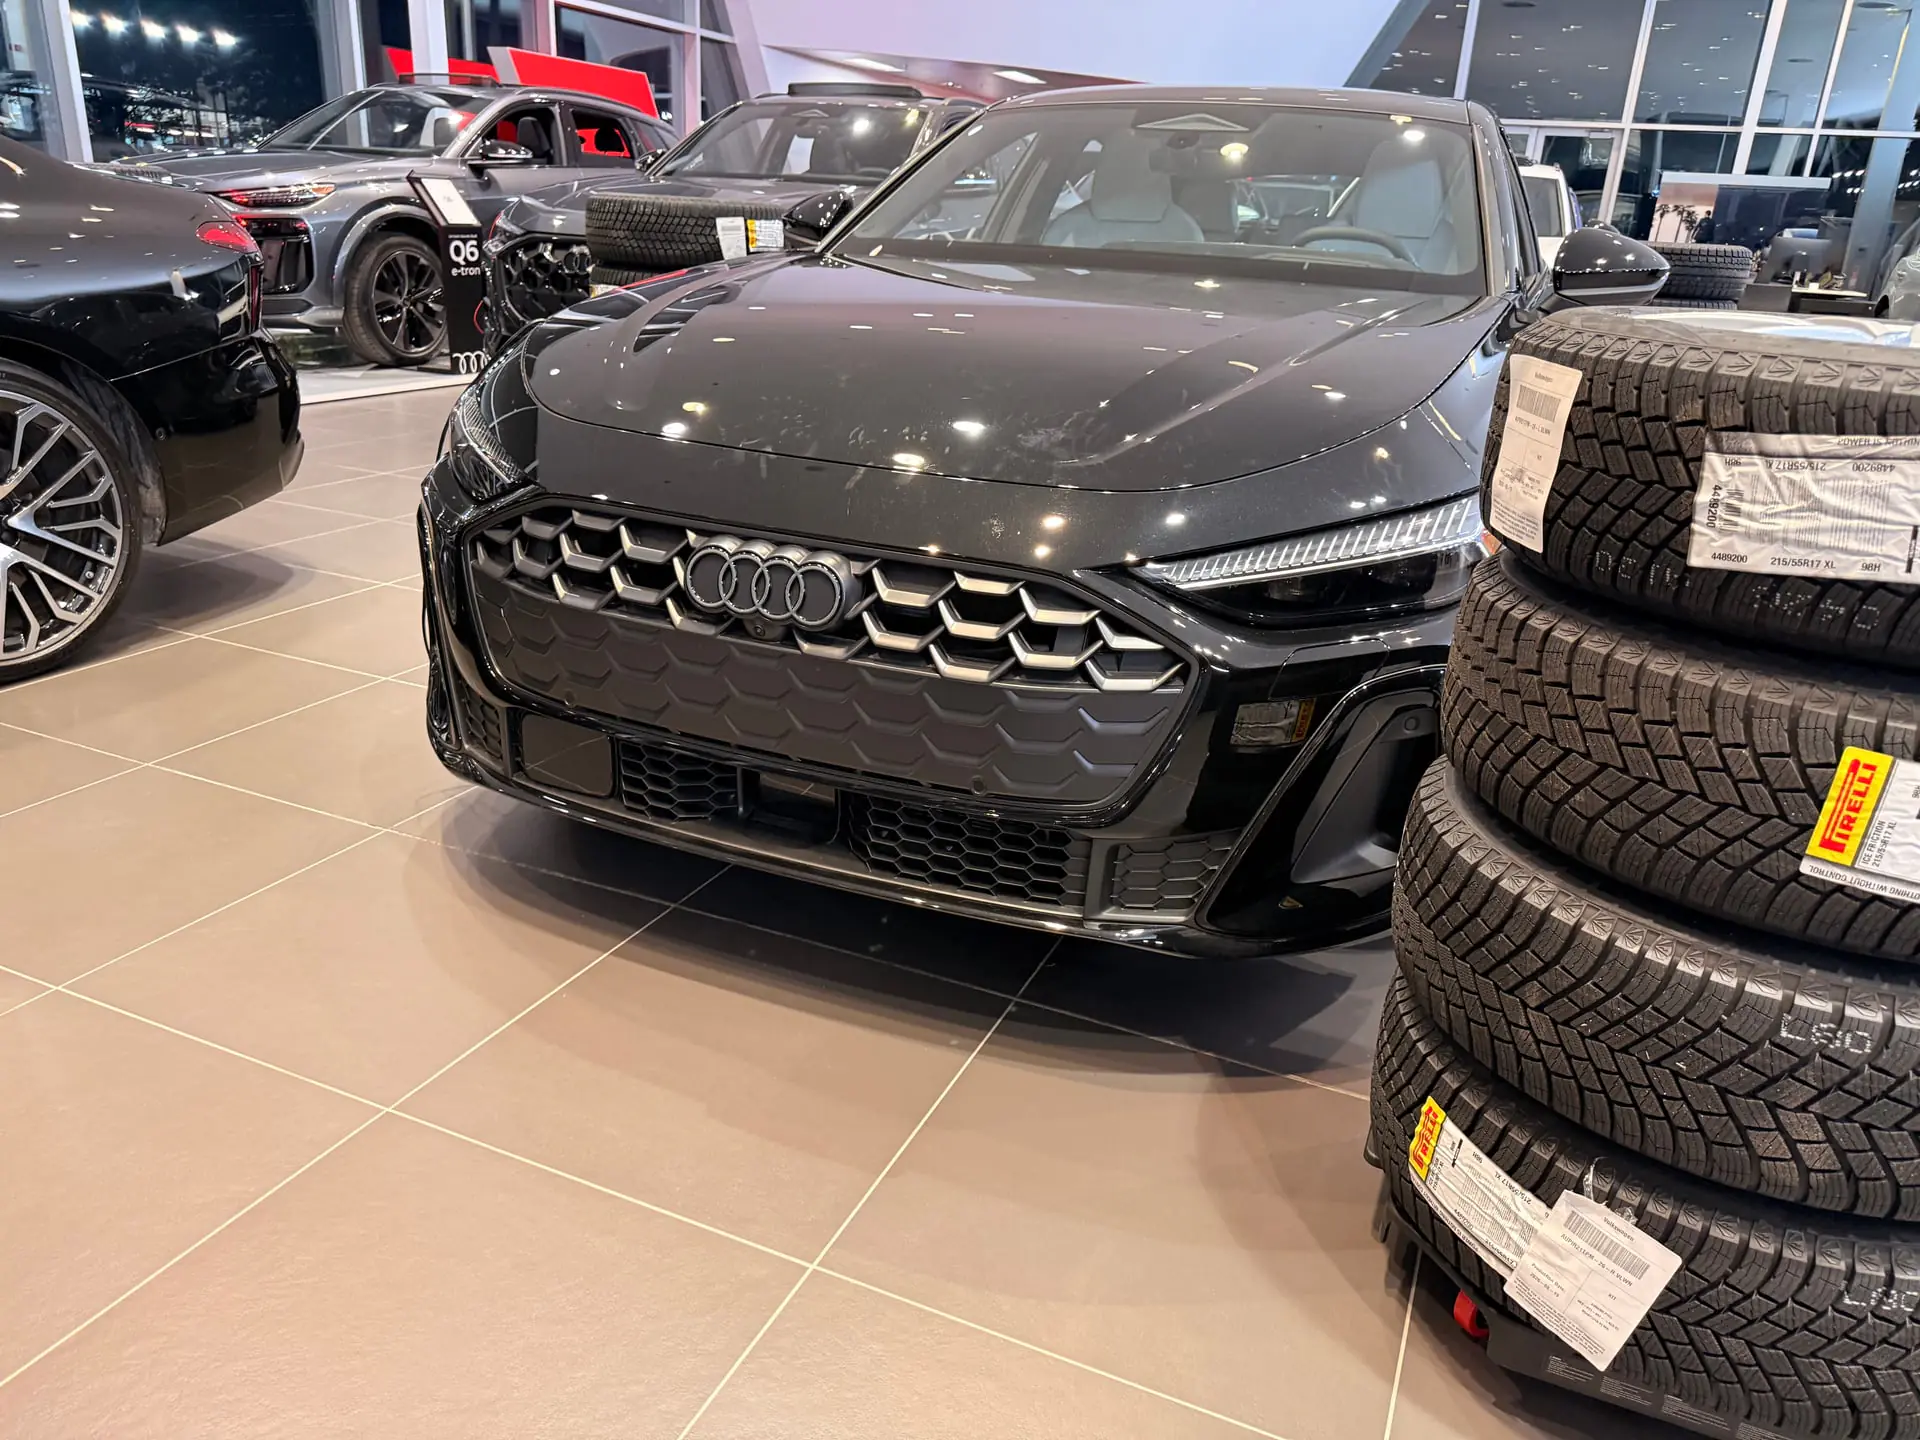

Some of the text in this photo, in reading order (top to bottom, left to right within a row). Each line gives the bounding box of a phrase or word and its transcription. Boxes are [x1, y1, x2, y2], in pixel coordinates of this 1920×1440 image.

[449, 240, 480, 265] Q6
[451, 267, 481, 276] e-tron
[1725, 458, 1742, 467] 98H
[1775, 461, 1826, 472] 215/55R17
[1852, 463, 1896, 473] 4489200
[1706, 484, 1722, 529] 4489200
[1711, 551, 1881, 572] 4489200 215/55R17 XL 98H
[1819, 758, 1878, 854] PIRELLI
[1862, 820, 1886, 865] ICE FRICTION
[1871, 819, 1897, 867] 215/55R17 XL
[1808, 864, 1848, 881] CONTROL
[1848, 875, 1888, 894] WITHOUT
[1413, 1105, 1439, 1170] PIRELLI
[1604, 1216, 1634, 1241] Volkswagen
